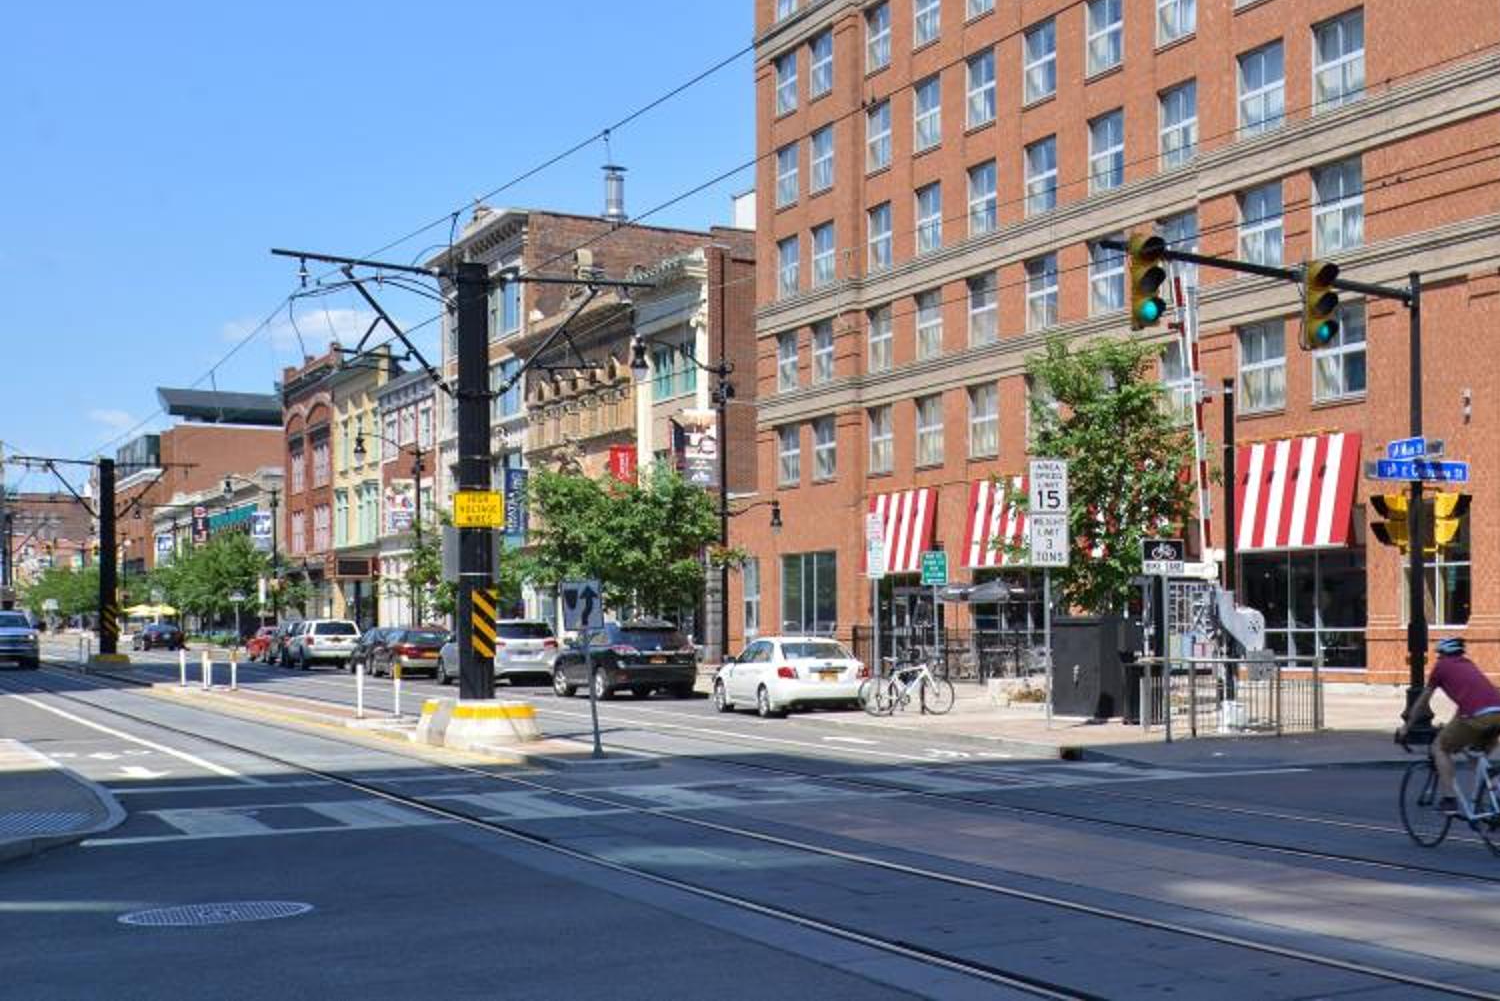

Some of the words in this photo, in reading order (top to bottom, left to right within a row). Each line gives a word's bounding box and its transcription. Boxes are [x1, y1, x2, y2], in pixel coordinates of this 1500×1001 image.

[1037, 489, 1061, 510] 15
[1046, 538, 1054, 550] 3
[1036, 551, 1064, 563] TONS
